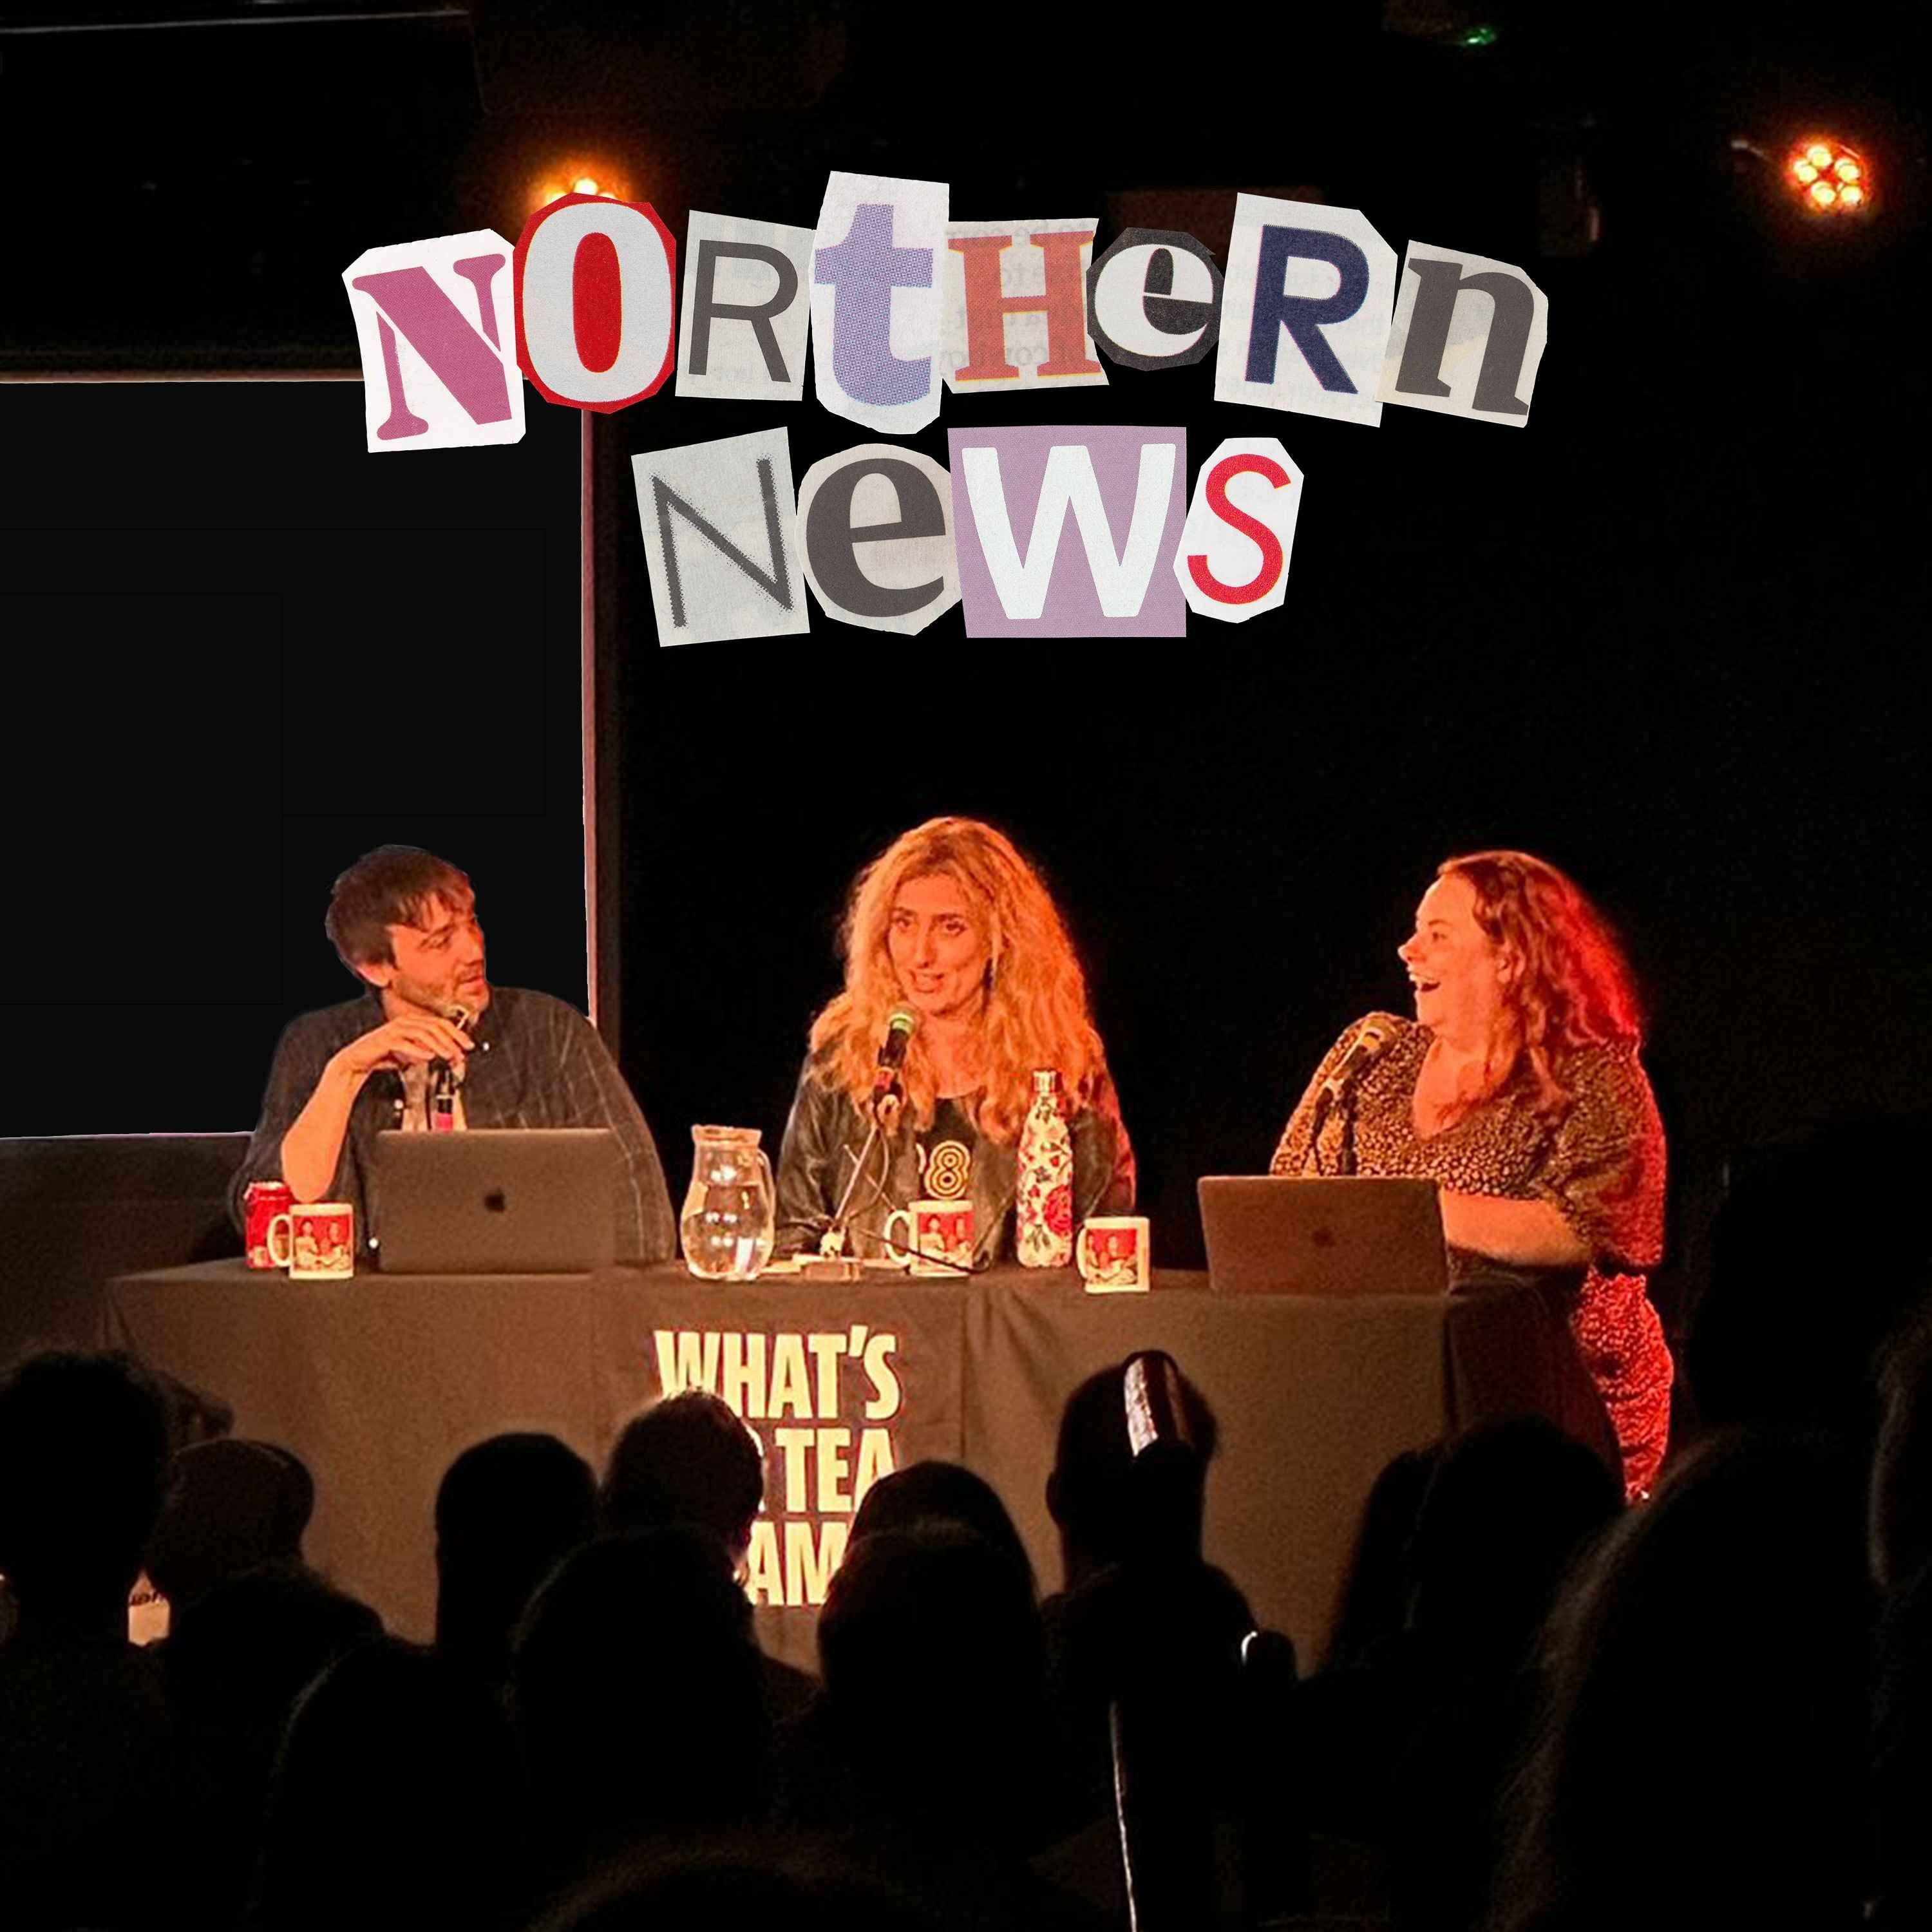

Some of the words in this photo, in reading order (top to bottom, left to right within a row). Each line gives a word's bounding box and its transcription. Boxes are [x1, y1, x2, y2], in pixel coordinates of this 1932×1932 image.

[916, 1141, 971, 1200] 8
[654, 1325, 901, 1419] WHAT'S
[747, 1521, 848, 1605] AM
